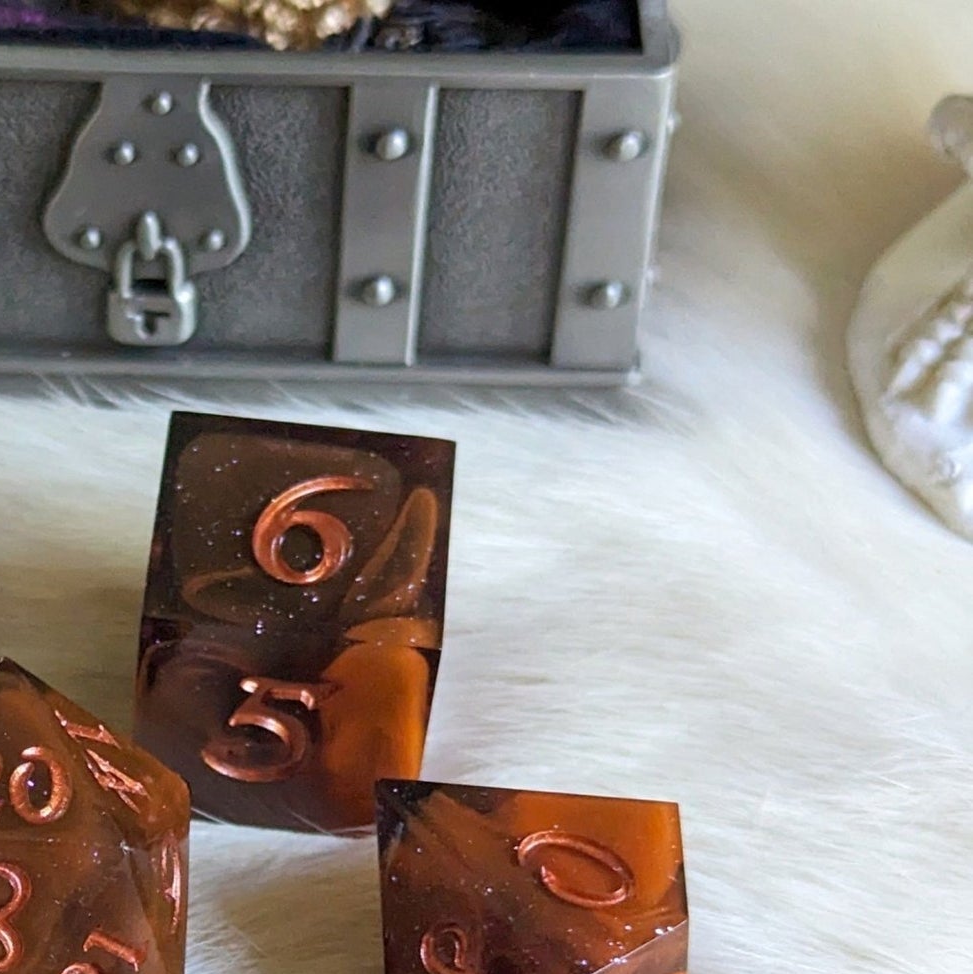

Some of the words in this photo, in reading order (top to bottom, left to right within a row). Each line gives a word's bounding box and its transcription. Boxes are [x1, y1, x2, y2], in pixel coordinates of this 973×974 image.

[253, 474, 383, 585] 6
[200, 676, 344, 782] 5
[517, 829, 635, 908] 0
